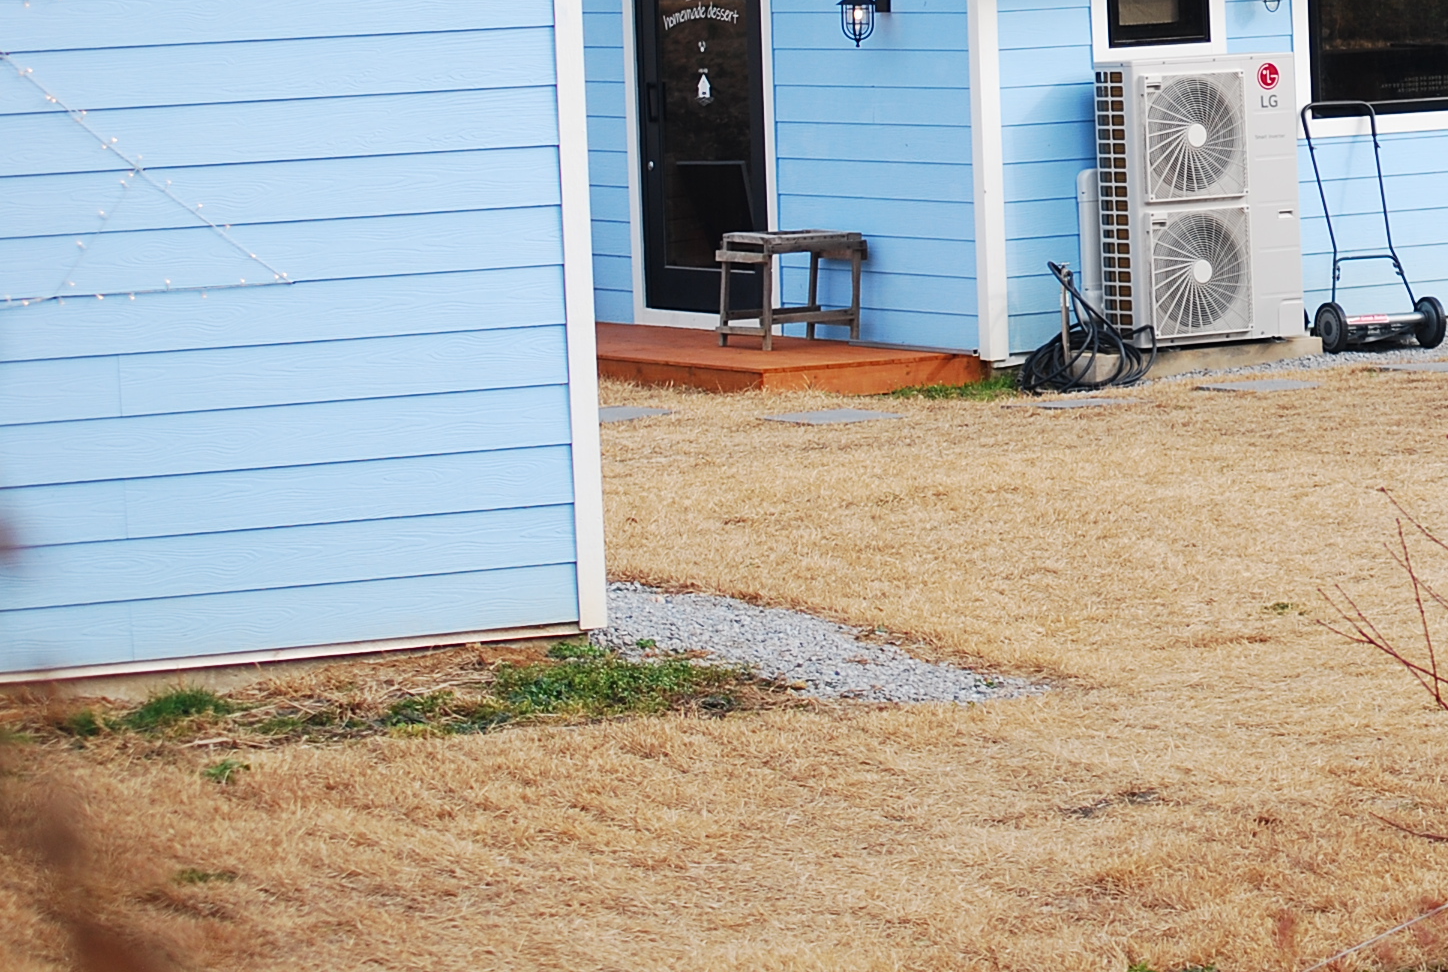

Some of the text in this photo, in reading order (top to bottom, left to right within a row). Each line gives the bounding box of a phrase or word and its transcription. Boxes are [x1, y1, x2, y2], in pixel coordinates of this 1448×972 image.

[663, 1, 739, 30] homemade dessert
[1260, 94, 1278, 109] LG
